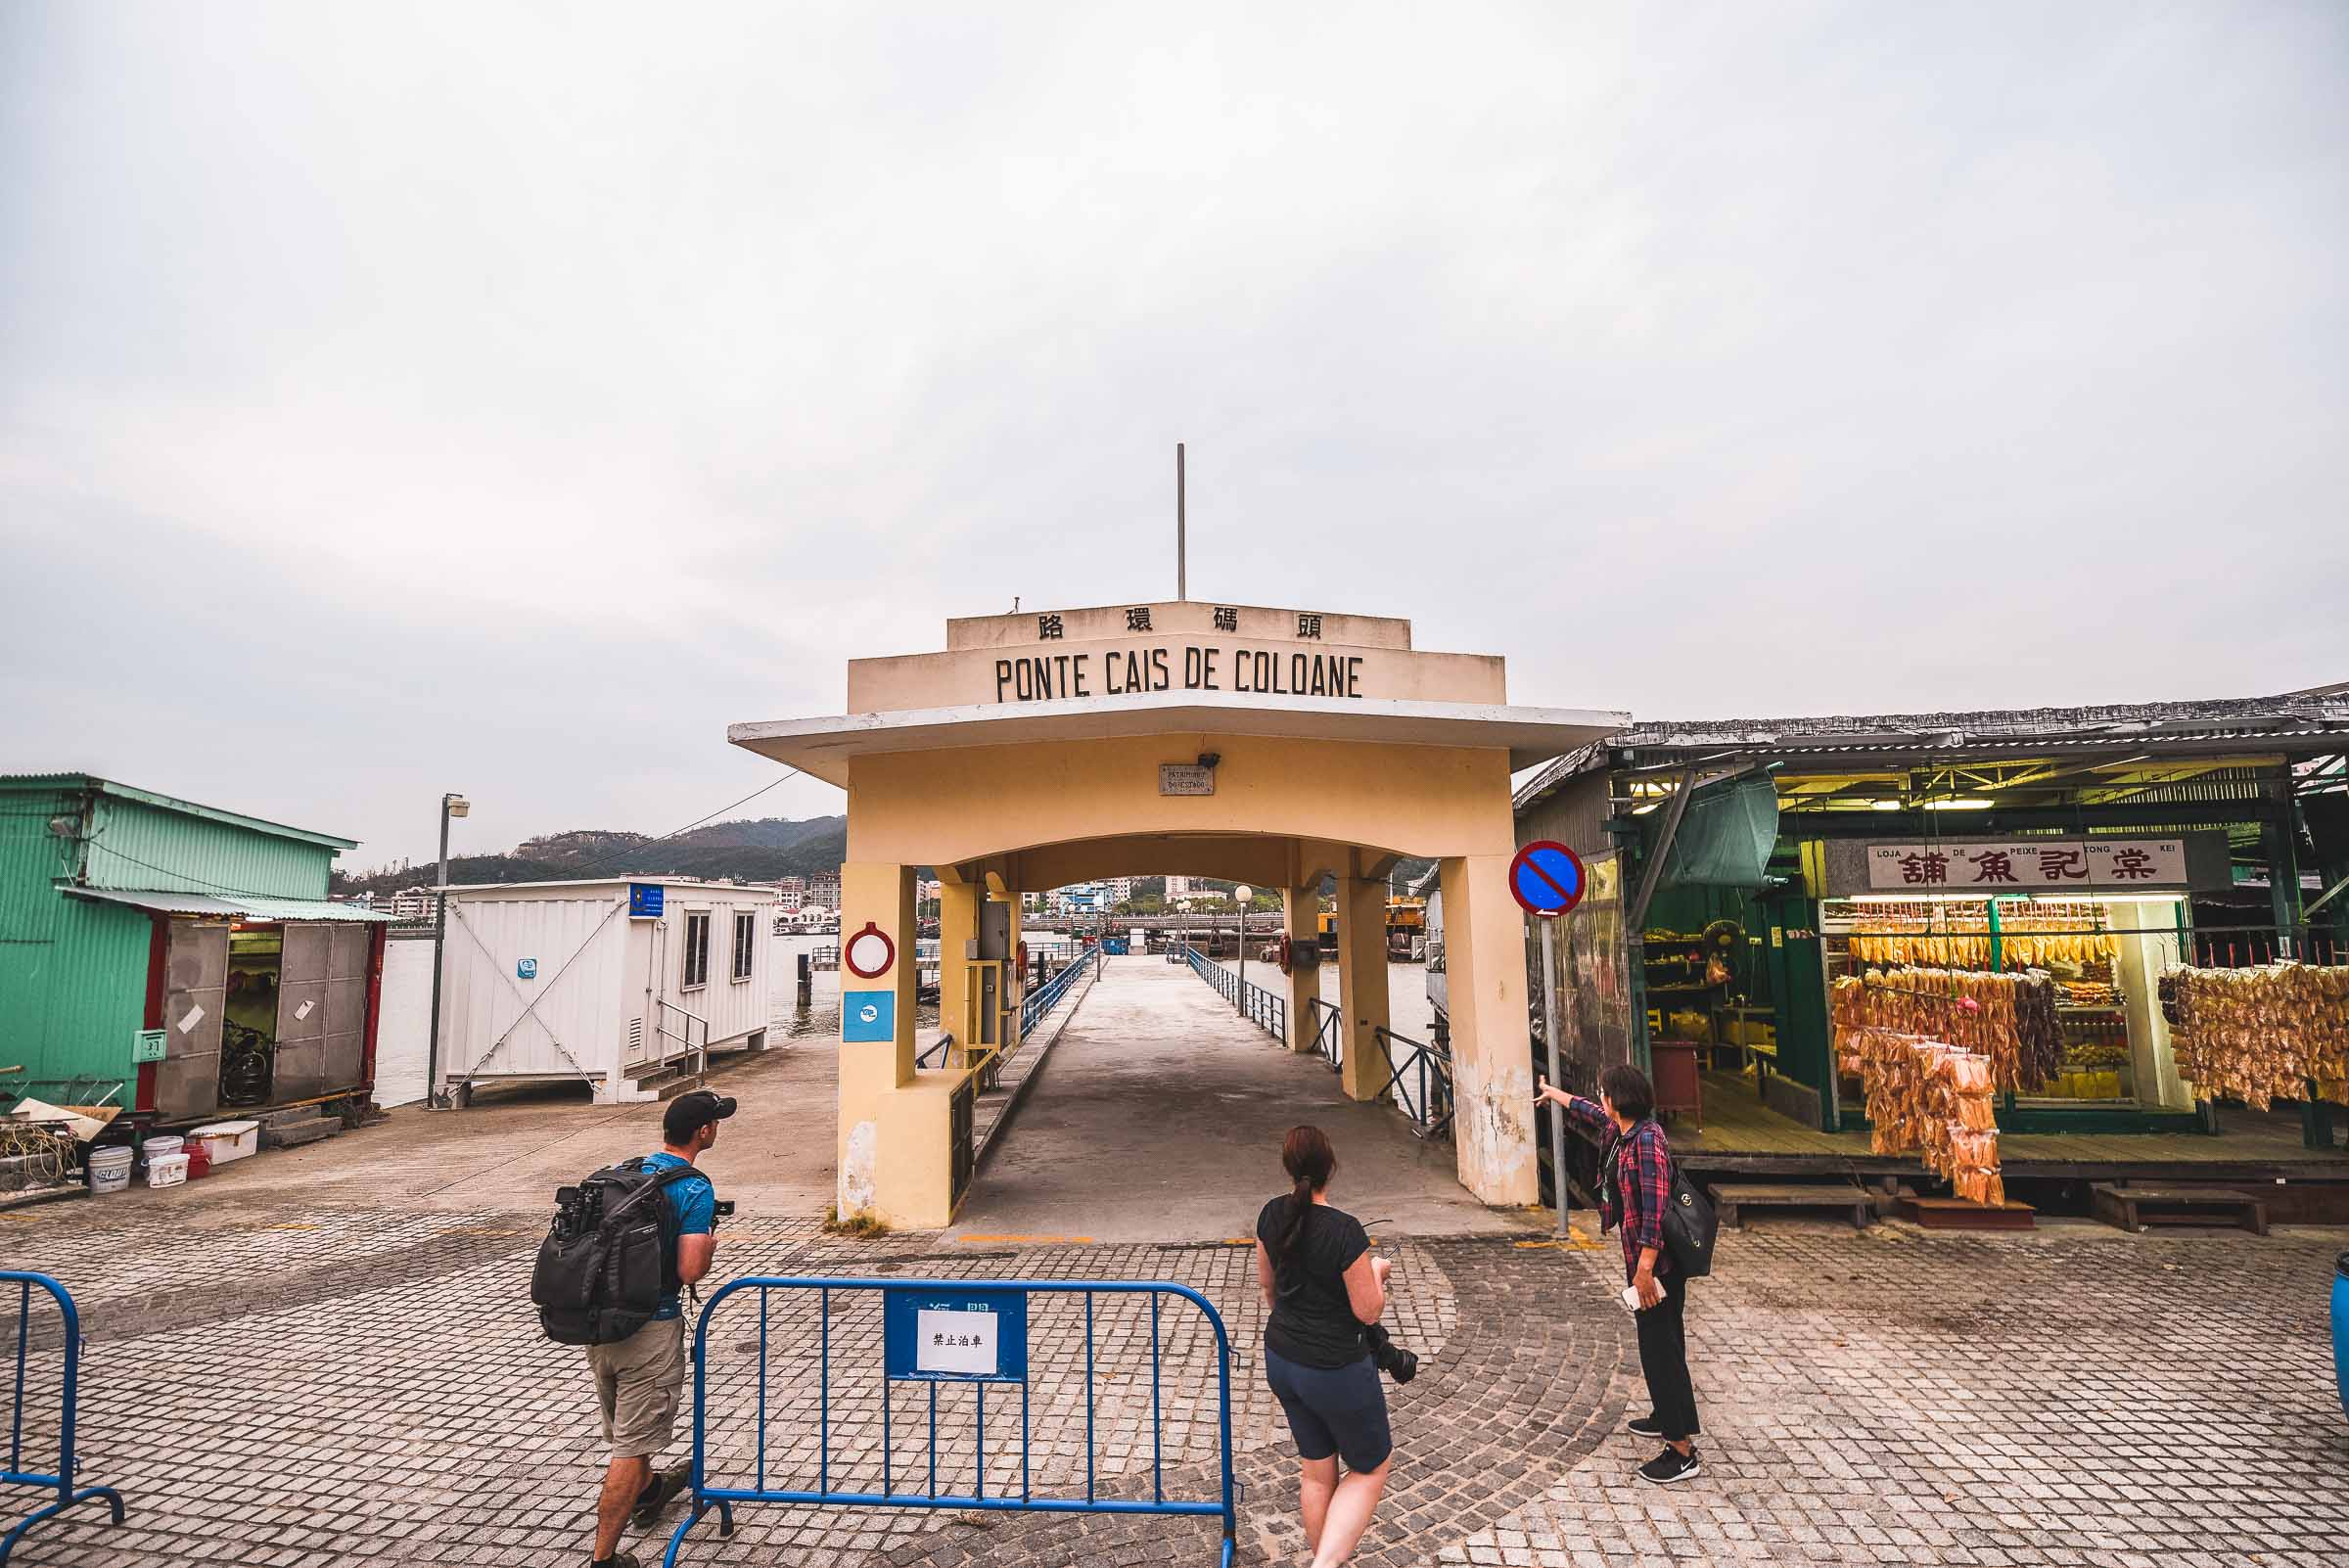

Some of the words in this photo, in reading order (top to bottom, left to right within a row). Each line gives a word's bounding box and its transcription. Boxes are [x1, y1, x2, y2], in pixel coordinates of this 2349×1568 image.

[1037, 607, 1322, 640] 路環碼頭
[995, 654, 1090, 704] PONTE
[1105, 648, 1170, 695] CAIS
[1184, 646, 1220, 690] DE
[1235, 649, 1363, 699] COLOANE
[1876, 850, 1902, 858] LOJA
[2009, 847, 2038, 856] PEIXE
[933, 1332, 983, 1348] 禁止泊車
